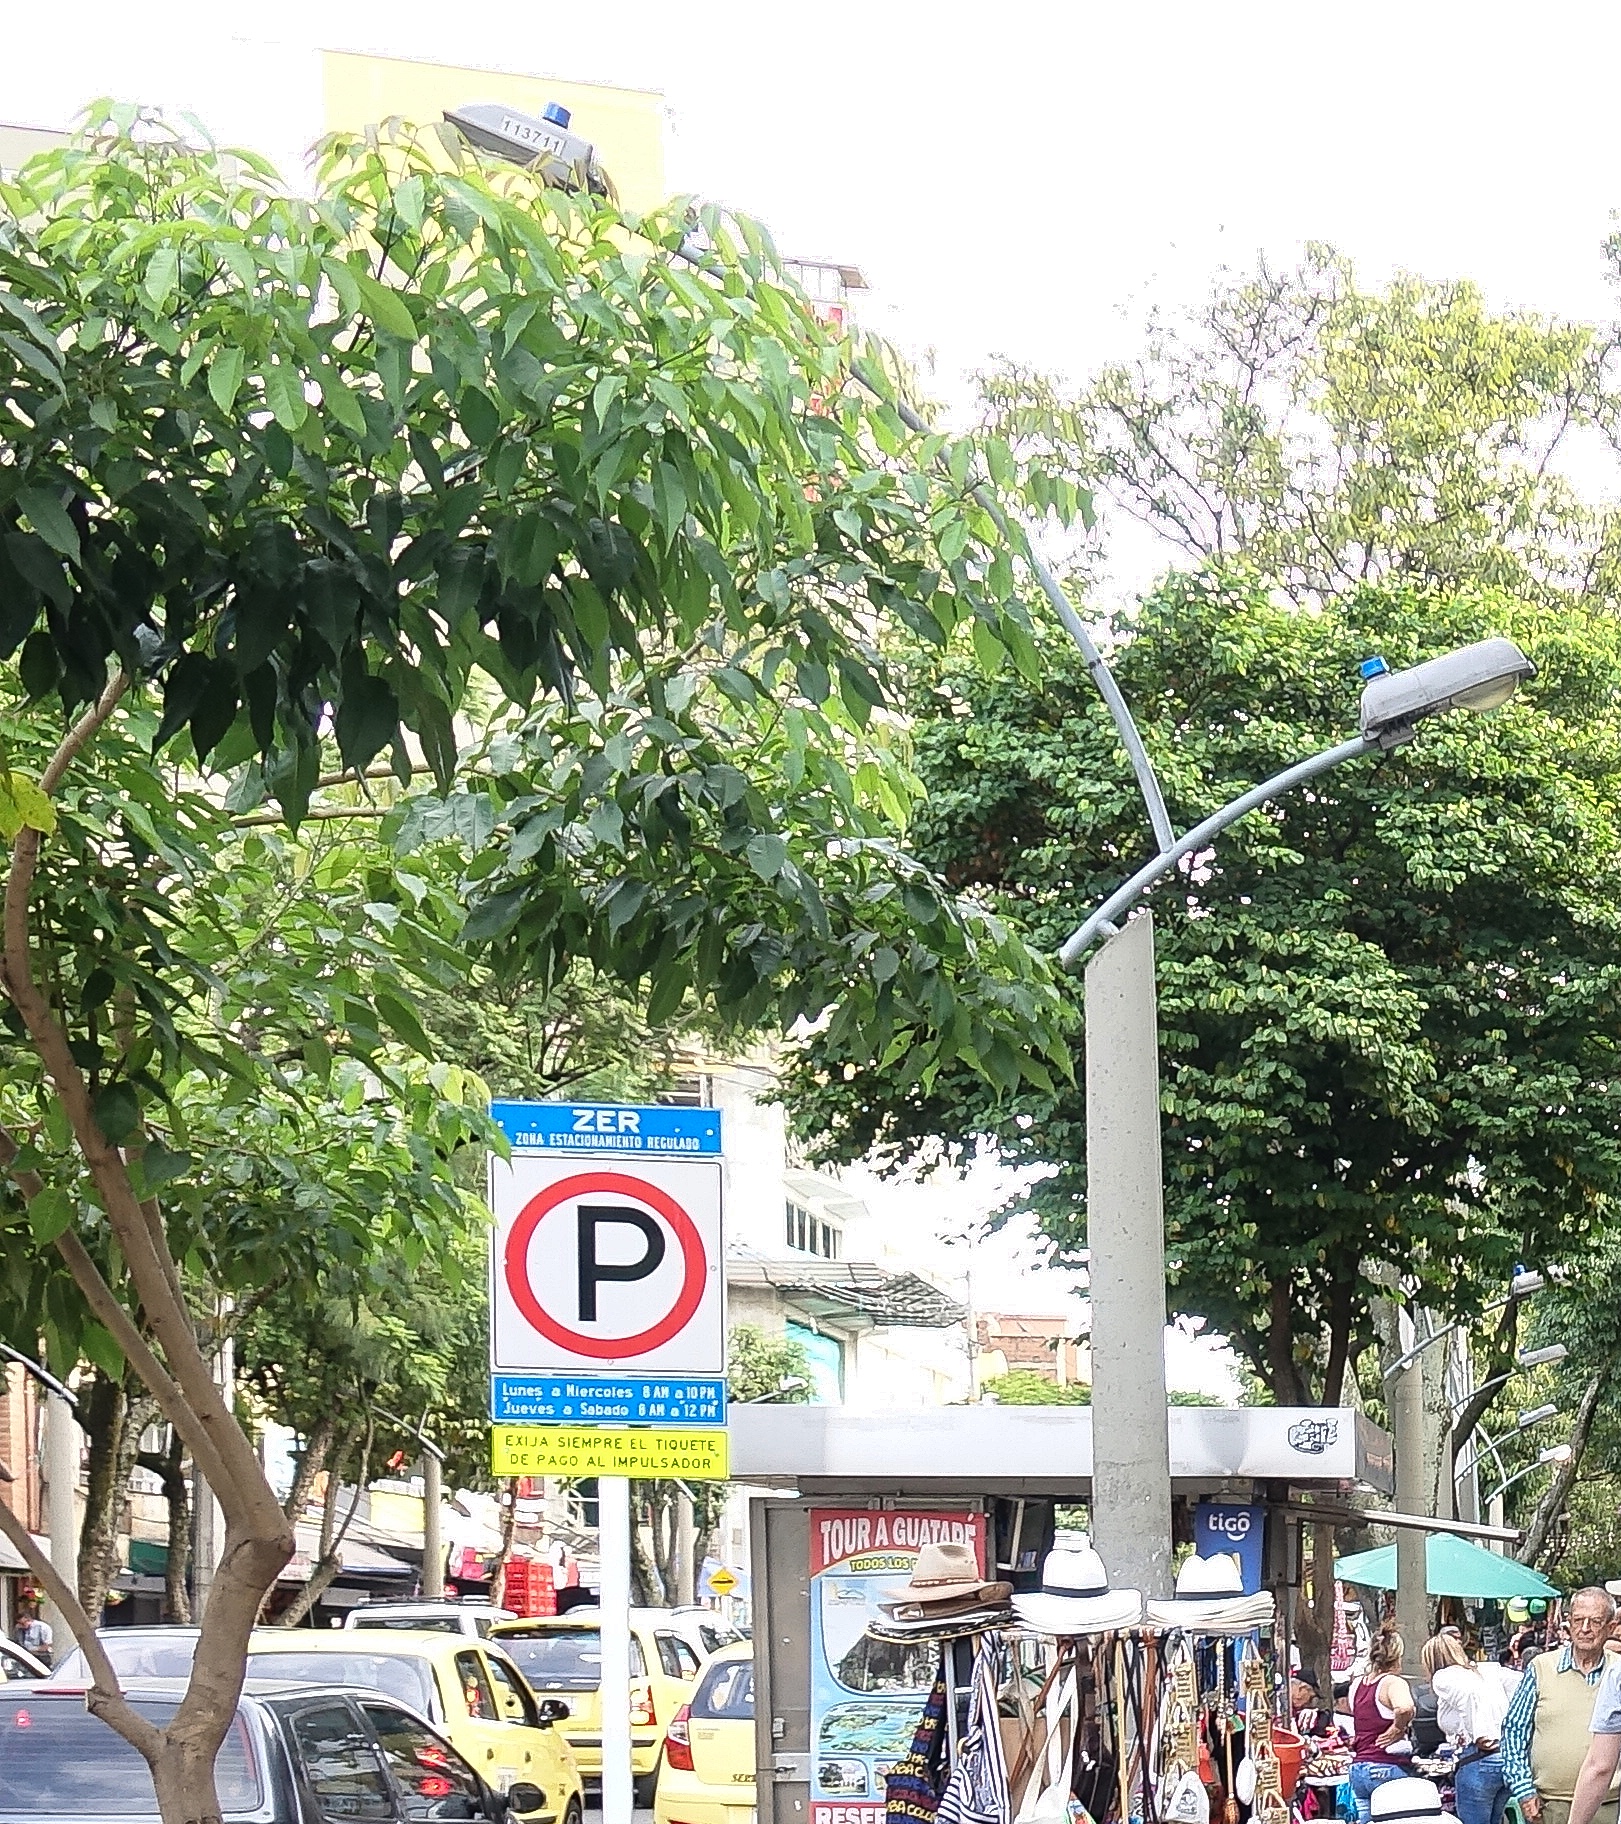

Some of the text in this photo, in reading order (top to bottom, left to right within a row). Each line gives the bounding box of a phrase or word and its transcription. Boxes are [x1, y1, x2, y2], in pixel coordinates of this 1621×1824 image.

[503, 120, 560, 152] 113711
[571, 1109, 641, 1133] ZER
[549, 1134, 642, 1149] ESTACIONAMIENTO
[646, 1136, 700, 1150] REGULADO
[577, 1205, 666, 1322] P
[501, 1383, 543, 1400] Lunes
[550, 1387, 560, 1399] a
[565, 1383, 633, 1400] Miercoles
[674, 1388, 685, 1401] a
[503, 1400, 555, 1415] Jueves
[562, 1404, 573, 1415] a
[580, 1400, 629, 1416] Sabado
[670, 1406, 680, 1417] a
[505, 1435, 716, 1452] EXIJA SIEMPRE EL TIQUETE
[510, 1453, 711, 1470] DE PAGO AL IMPULSADOR
[820, 1516, 870, 1565] TOUR
[874, 1517, 890, 1548] A
[851, 1557, 886, 1572] TODOS
[888, 1556, 910, 1571] LOS
